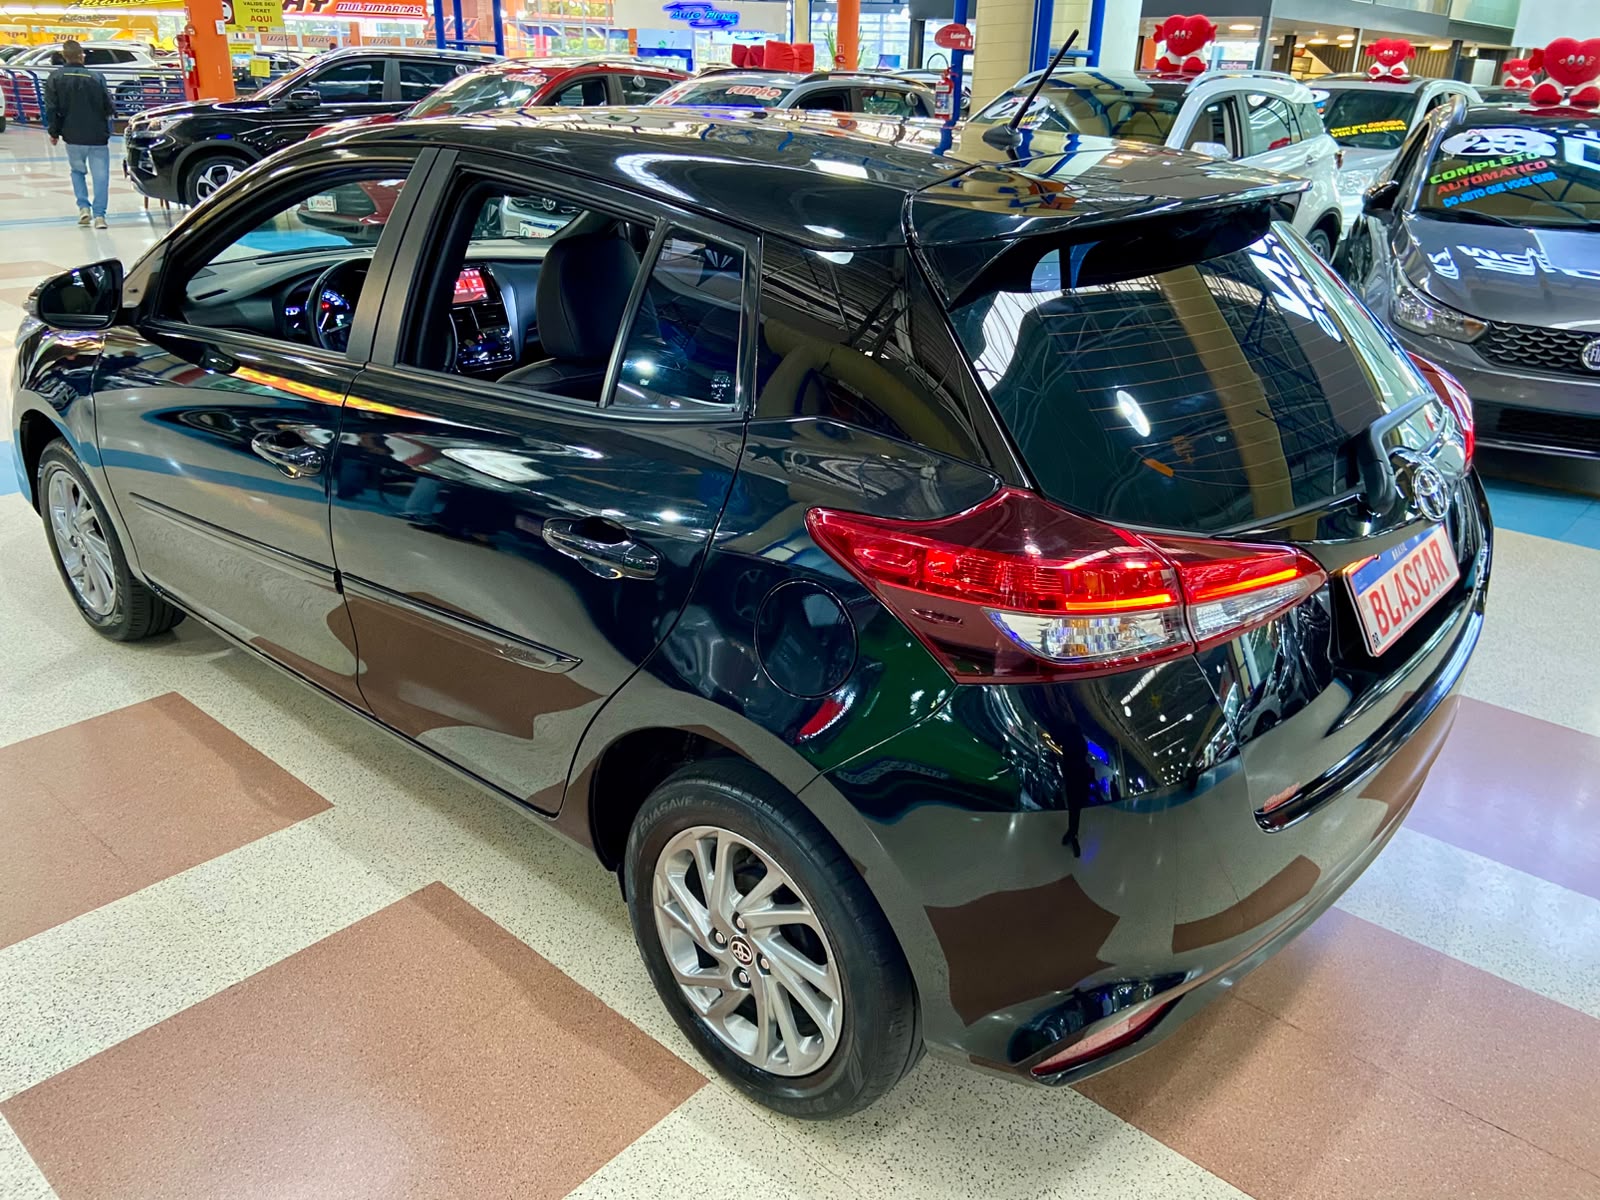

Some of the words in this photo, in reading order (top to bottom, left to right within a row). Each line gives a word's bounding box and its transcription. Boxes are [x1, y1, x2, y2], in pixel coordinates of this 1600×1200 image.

[250, 15, 273, 23] AQUI
[335, 2, 422, 14] MULTIMARCAS
[671, 10, 701, 20] Auto
[1429, 151, 1541, 185] COMPLETO
[1437, 160, 1549, 195] AUTOMATICO
[1442, 195, 1460, 208] DO
[1460, 188, 1487, 203] JEITO
[1486, 182, 1507, 196] QUE
[1368, 538, 1450, 637] BLASCAR
[640, 795, 695, 836] ENASAVE
